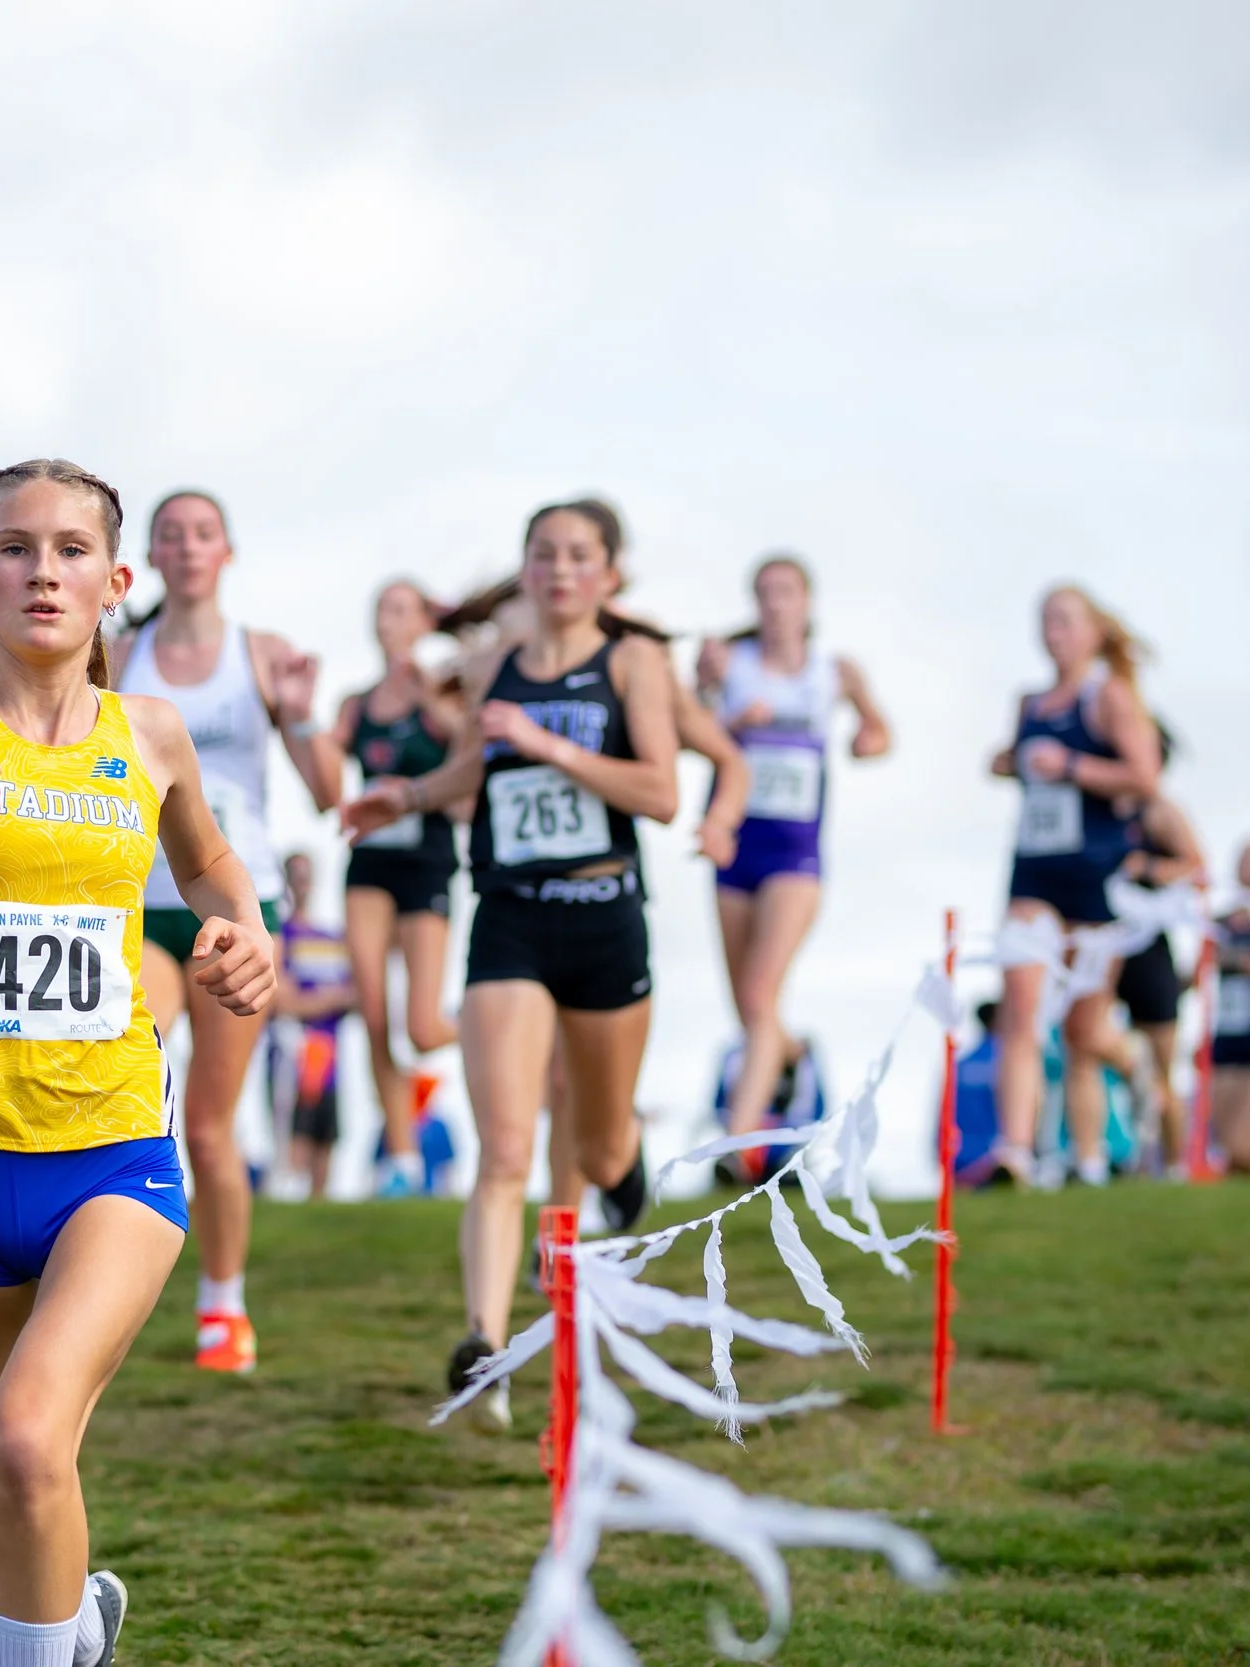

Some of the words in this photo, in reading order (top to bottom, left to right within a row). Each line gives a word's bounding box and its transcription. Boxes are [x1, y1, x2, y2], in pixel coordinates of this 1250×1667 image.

[511, 786, 582, 841] 263
[10, 913, 43, 926] PAYNE
[77, 916, 107, 931] INVITE
